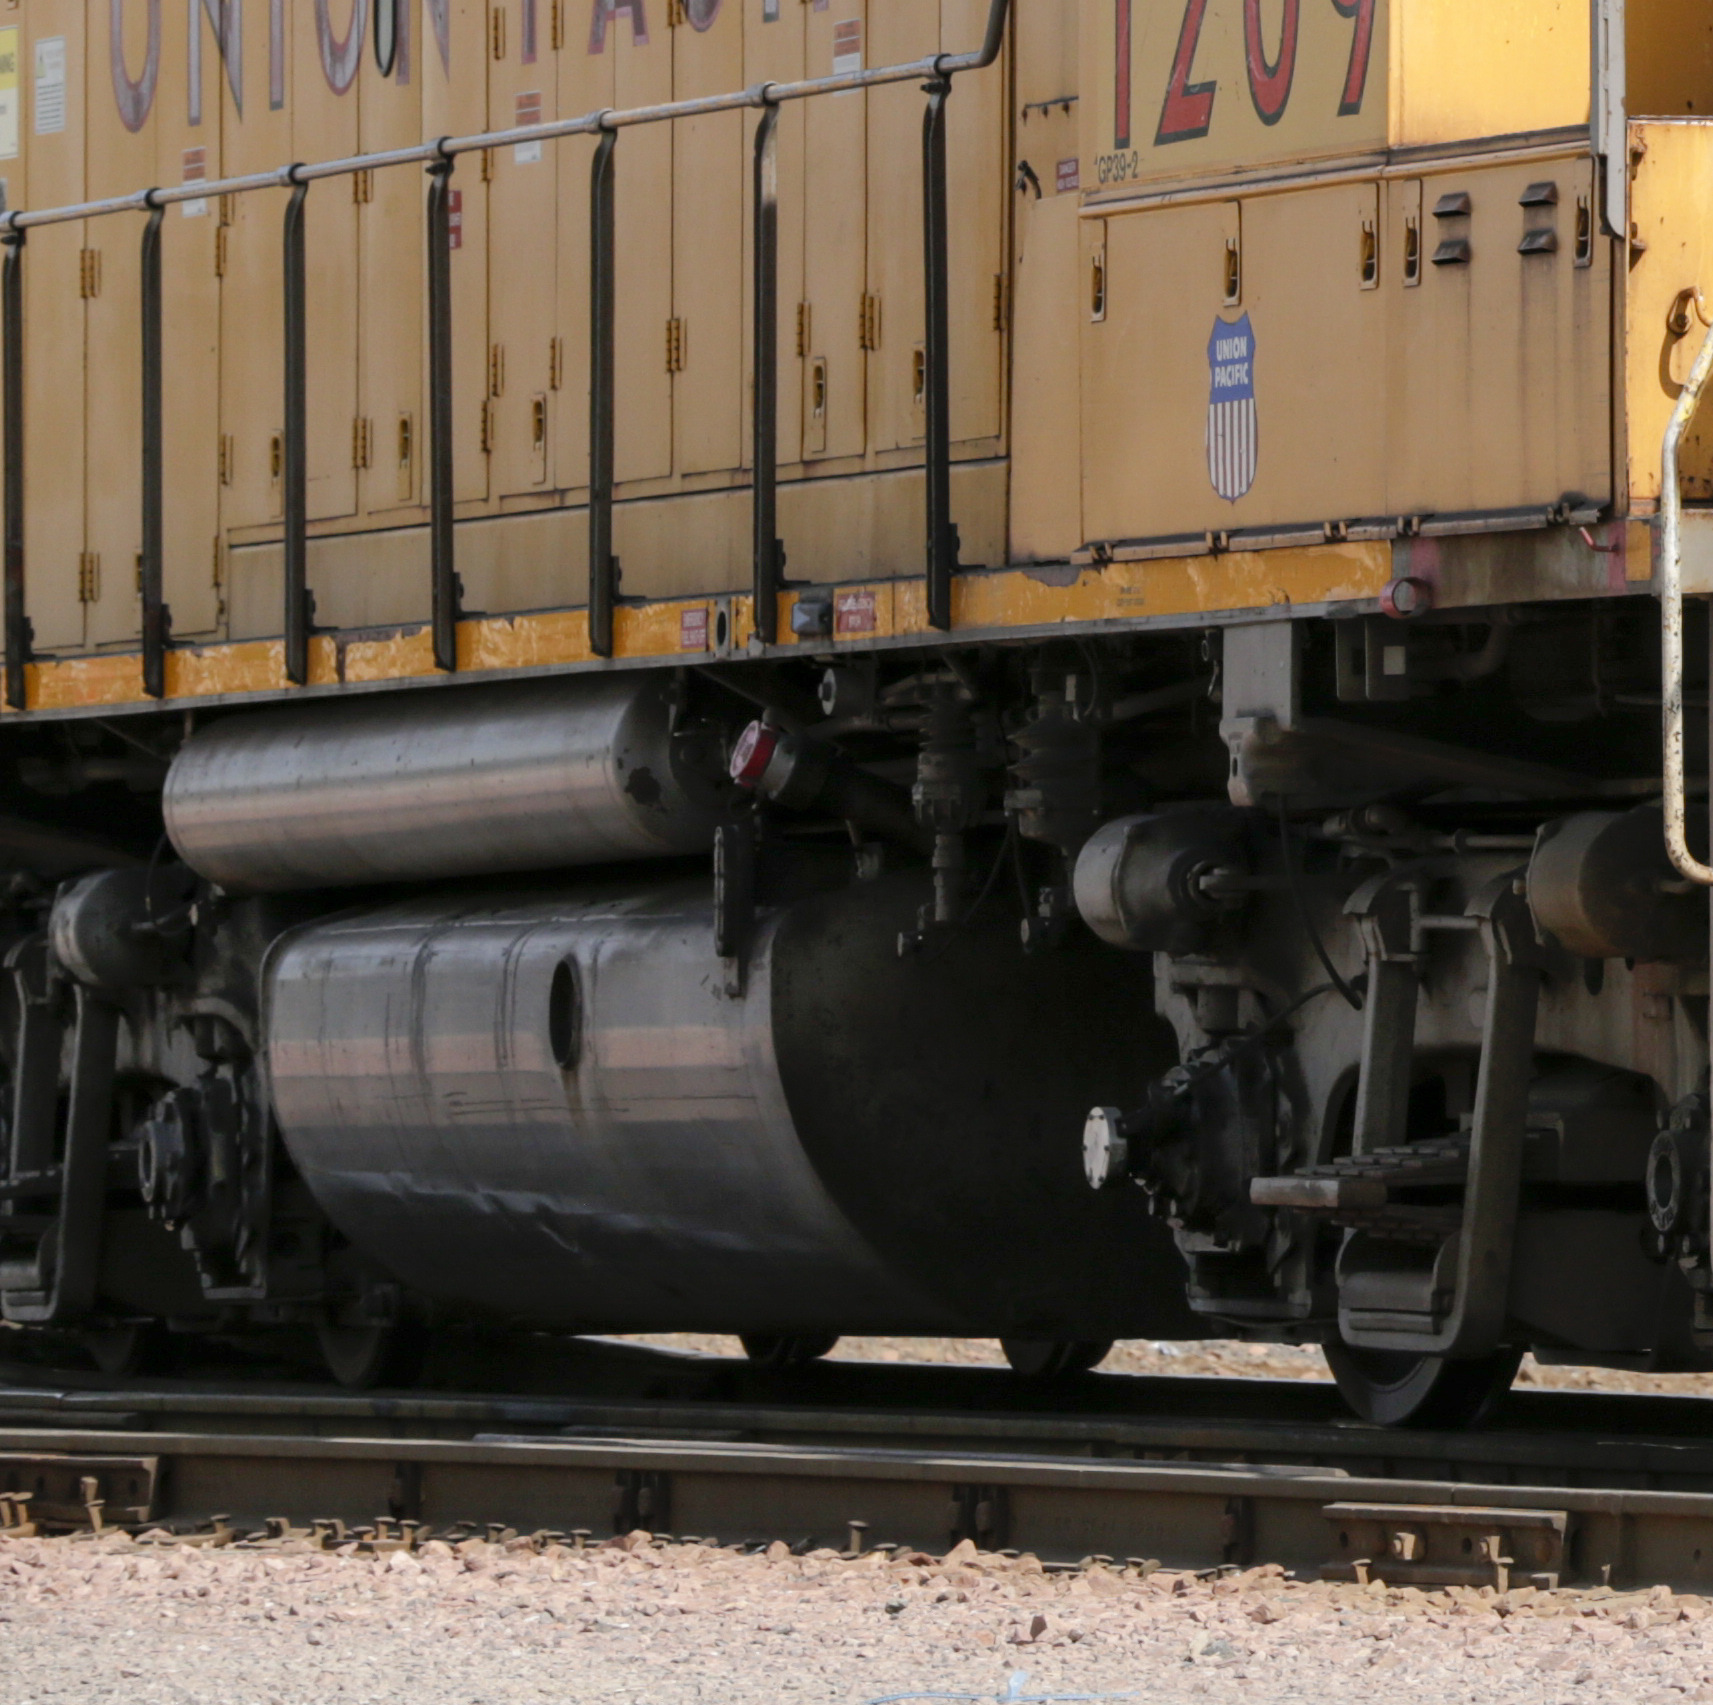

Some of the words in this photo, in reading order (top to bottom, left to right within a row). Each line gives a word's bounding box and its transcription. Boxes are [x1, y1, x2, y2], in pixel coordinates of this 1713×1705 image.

[1097, 150, 1139, 185] GP39-2
[1215, 335, 1248, 361] UNION
[1214, 362, 1249, 388] PACIFIC
